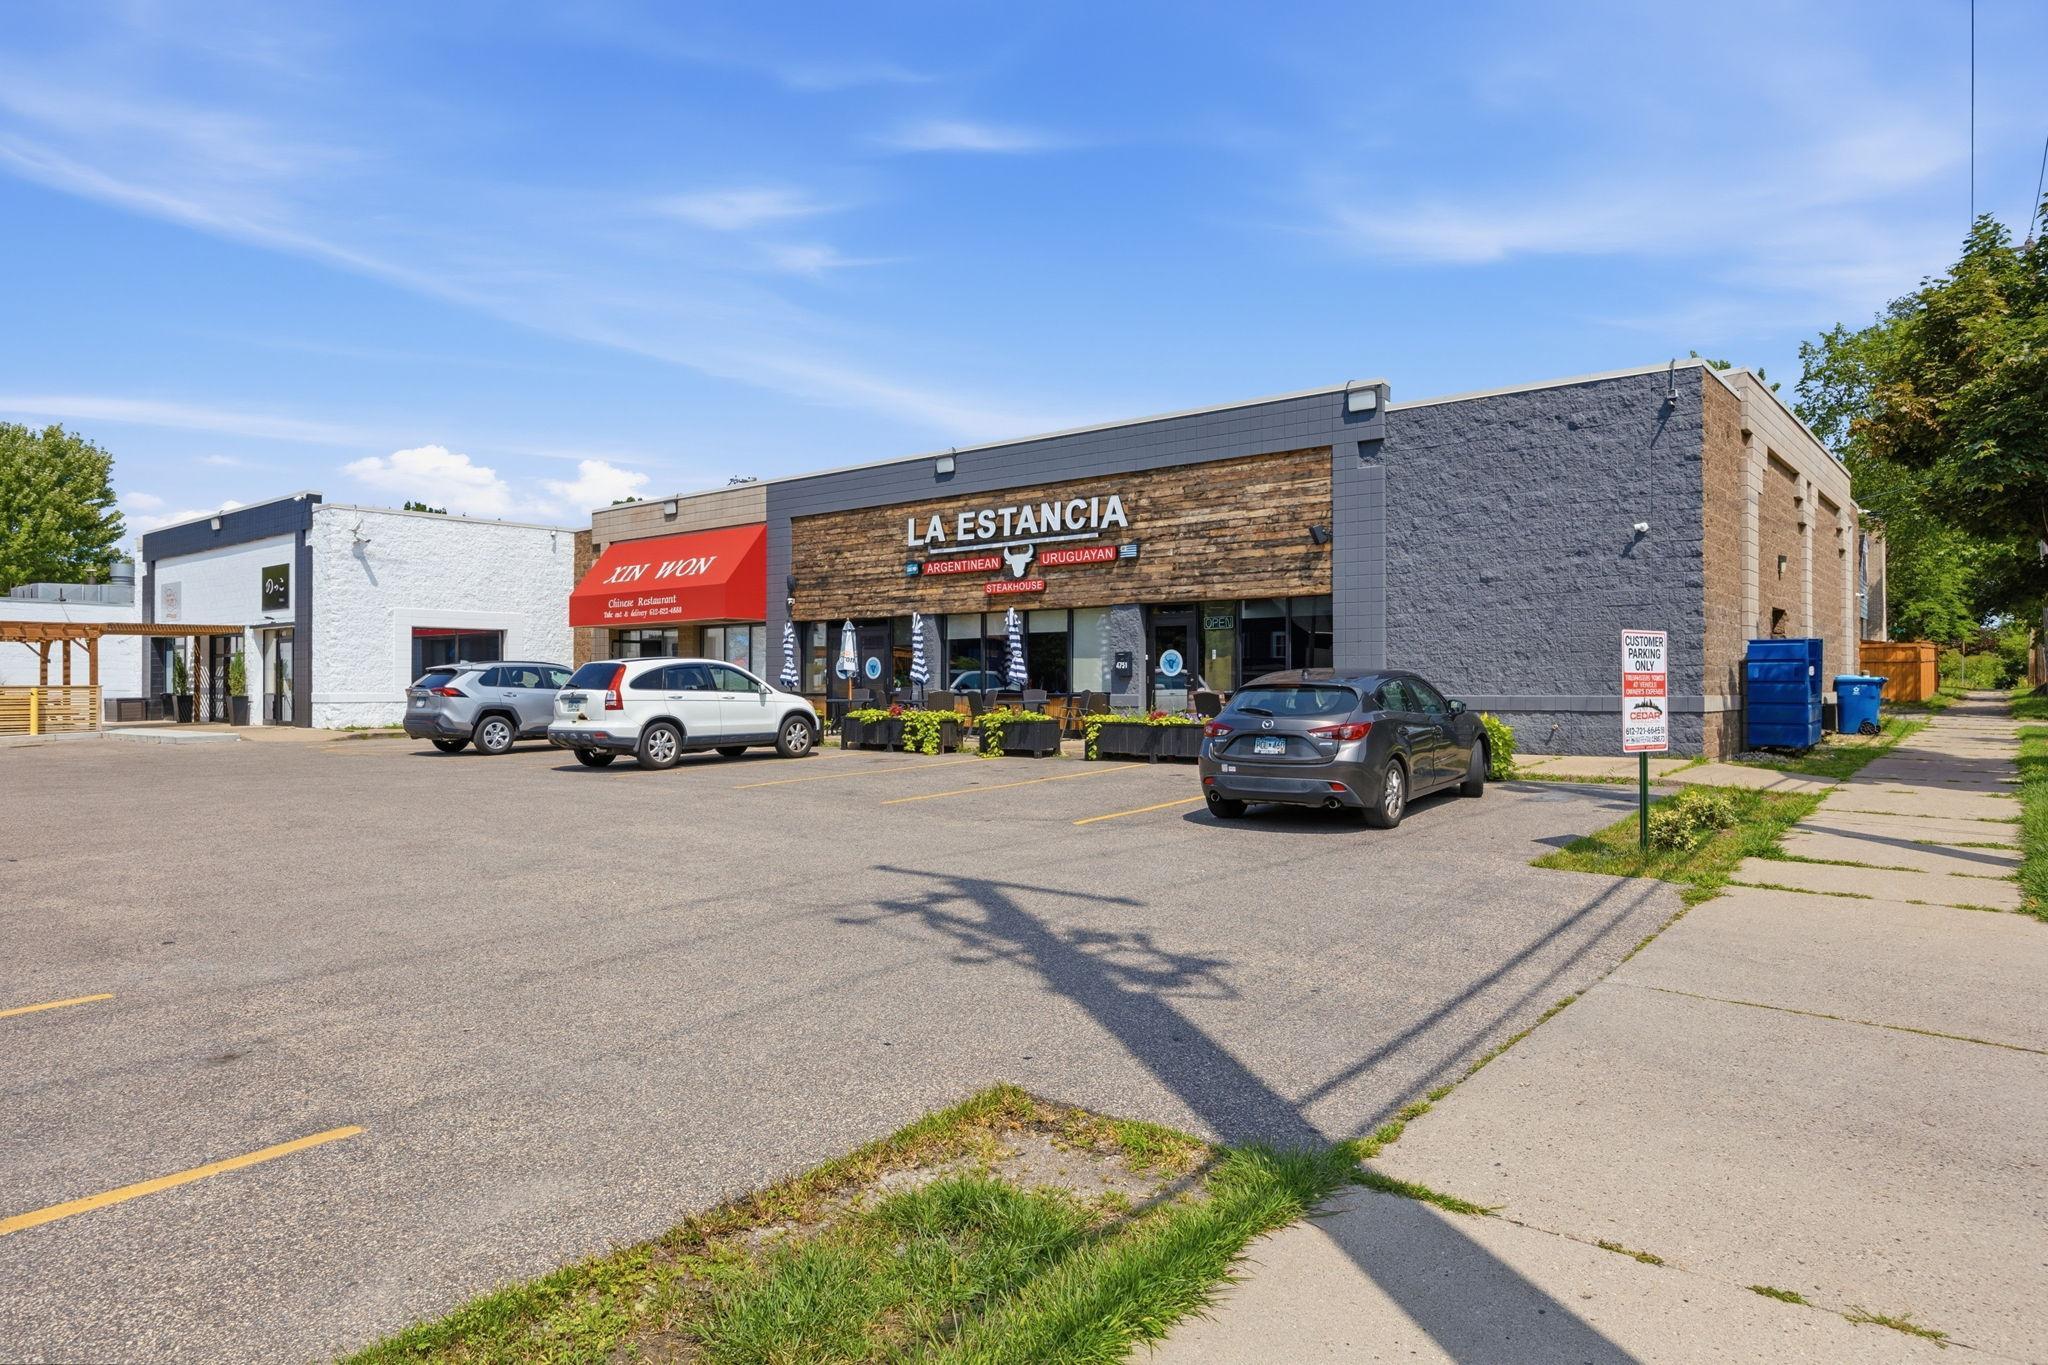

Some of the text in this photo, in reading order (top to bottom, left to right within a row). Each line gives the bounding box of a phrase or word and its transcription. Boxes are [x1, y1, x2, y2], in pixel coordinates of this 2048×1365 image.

[908, 495, 1129, 546] LA ESTANCIA
[1042, 549, 1113, 565] URUGUAYAN
[602, 555, 718, 584] XIN WON
[927, 558, 999, 574] ARGENTINEAN
[986, 580, 1043, 593] STEAKHOUSE
[608, 595, 676, 609] Chinese Restaurant
[1205, 617, 1232, 628] OPEN
[1625, 635, 1664, 647] CUSTOMER
[1628, 648, 1661, 659] PARKING
[1635, 660, 1654, 671] ONLY
[1630, 711, 1661, 720] CEDAR
